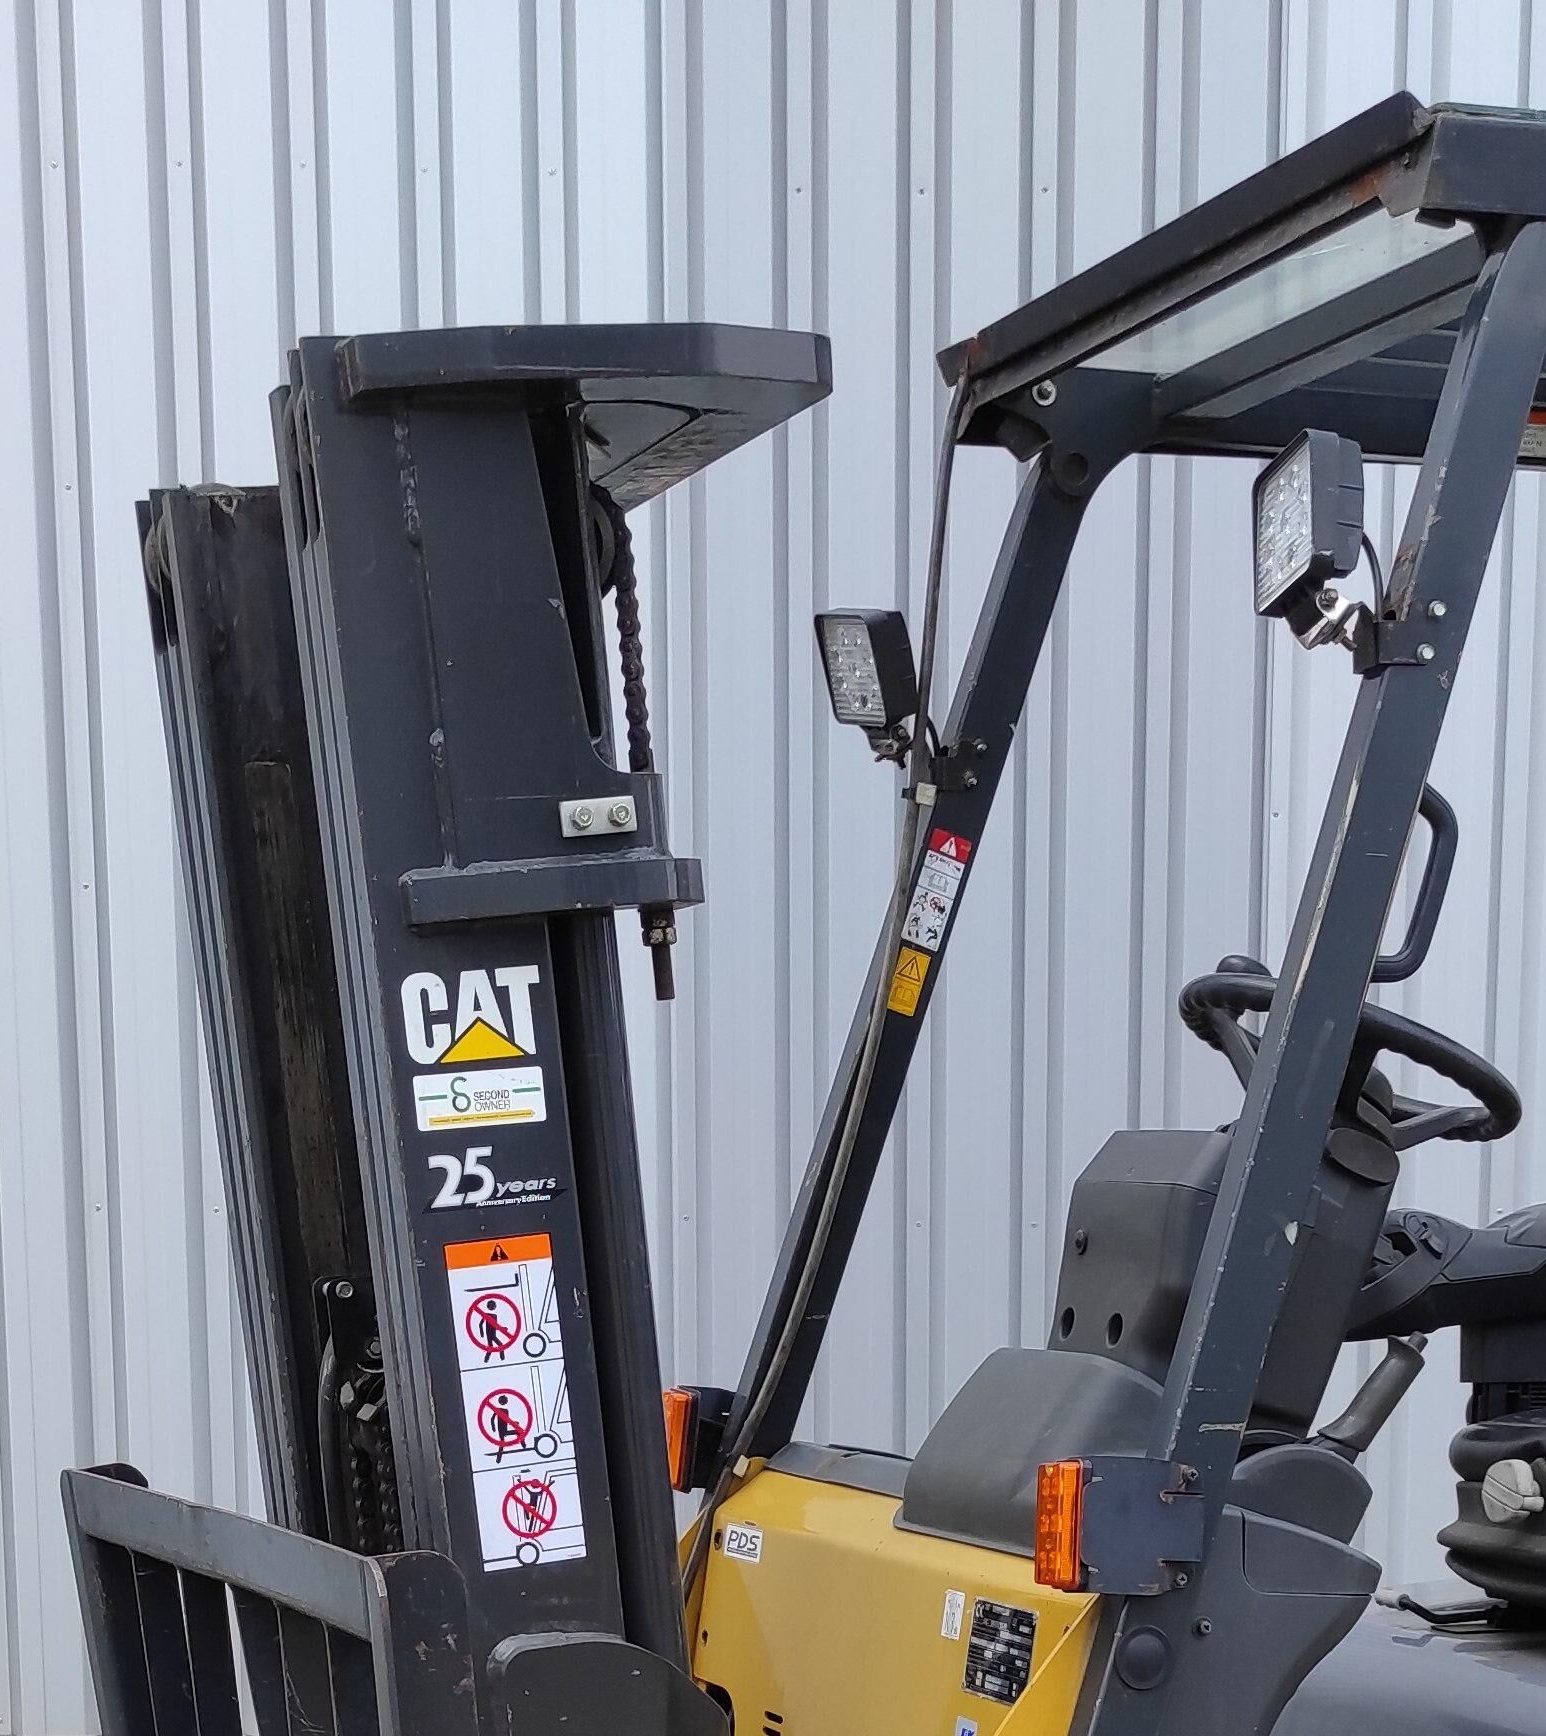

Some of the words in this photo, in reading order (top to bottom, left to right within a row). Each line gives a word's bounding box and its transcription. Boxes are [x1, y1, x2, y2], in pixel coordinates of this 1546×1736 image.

[401, 965, 540, 1065] CAT
[473, 1089, 510, 1102] SECOND
[428, 1145, 495, 1209] 25
[496, 1178, 557, 1198] years
[727, 1530, 761, 1552] PDS
